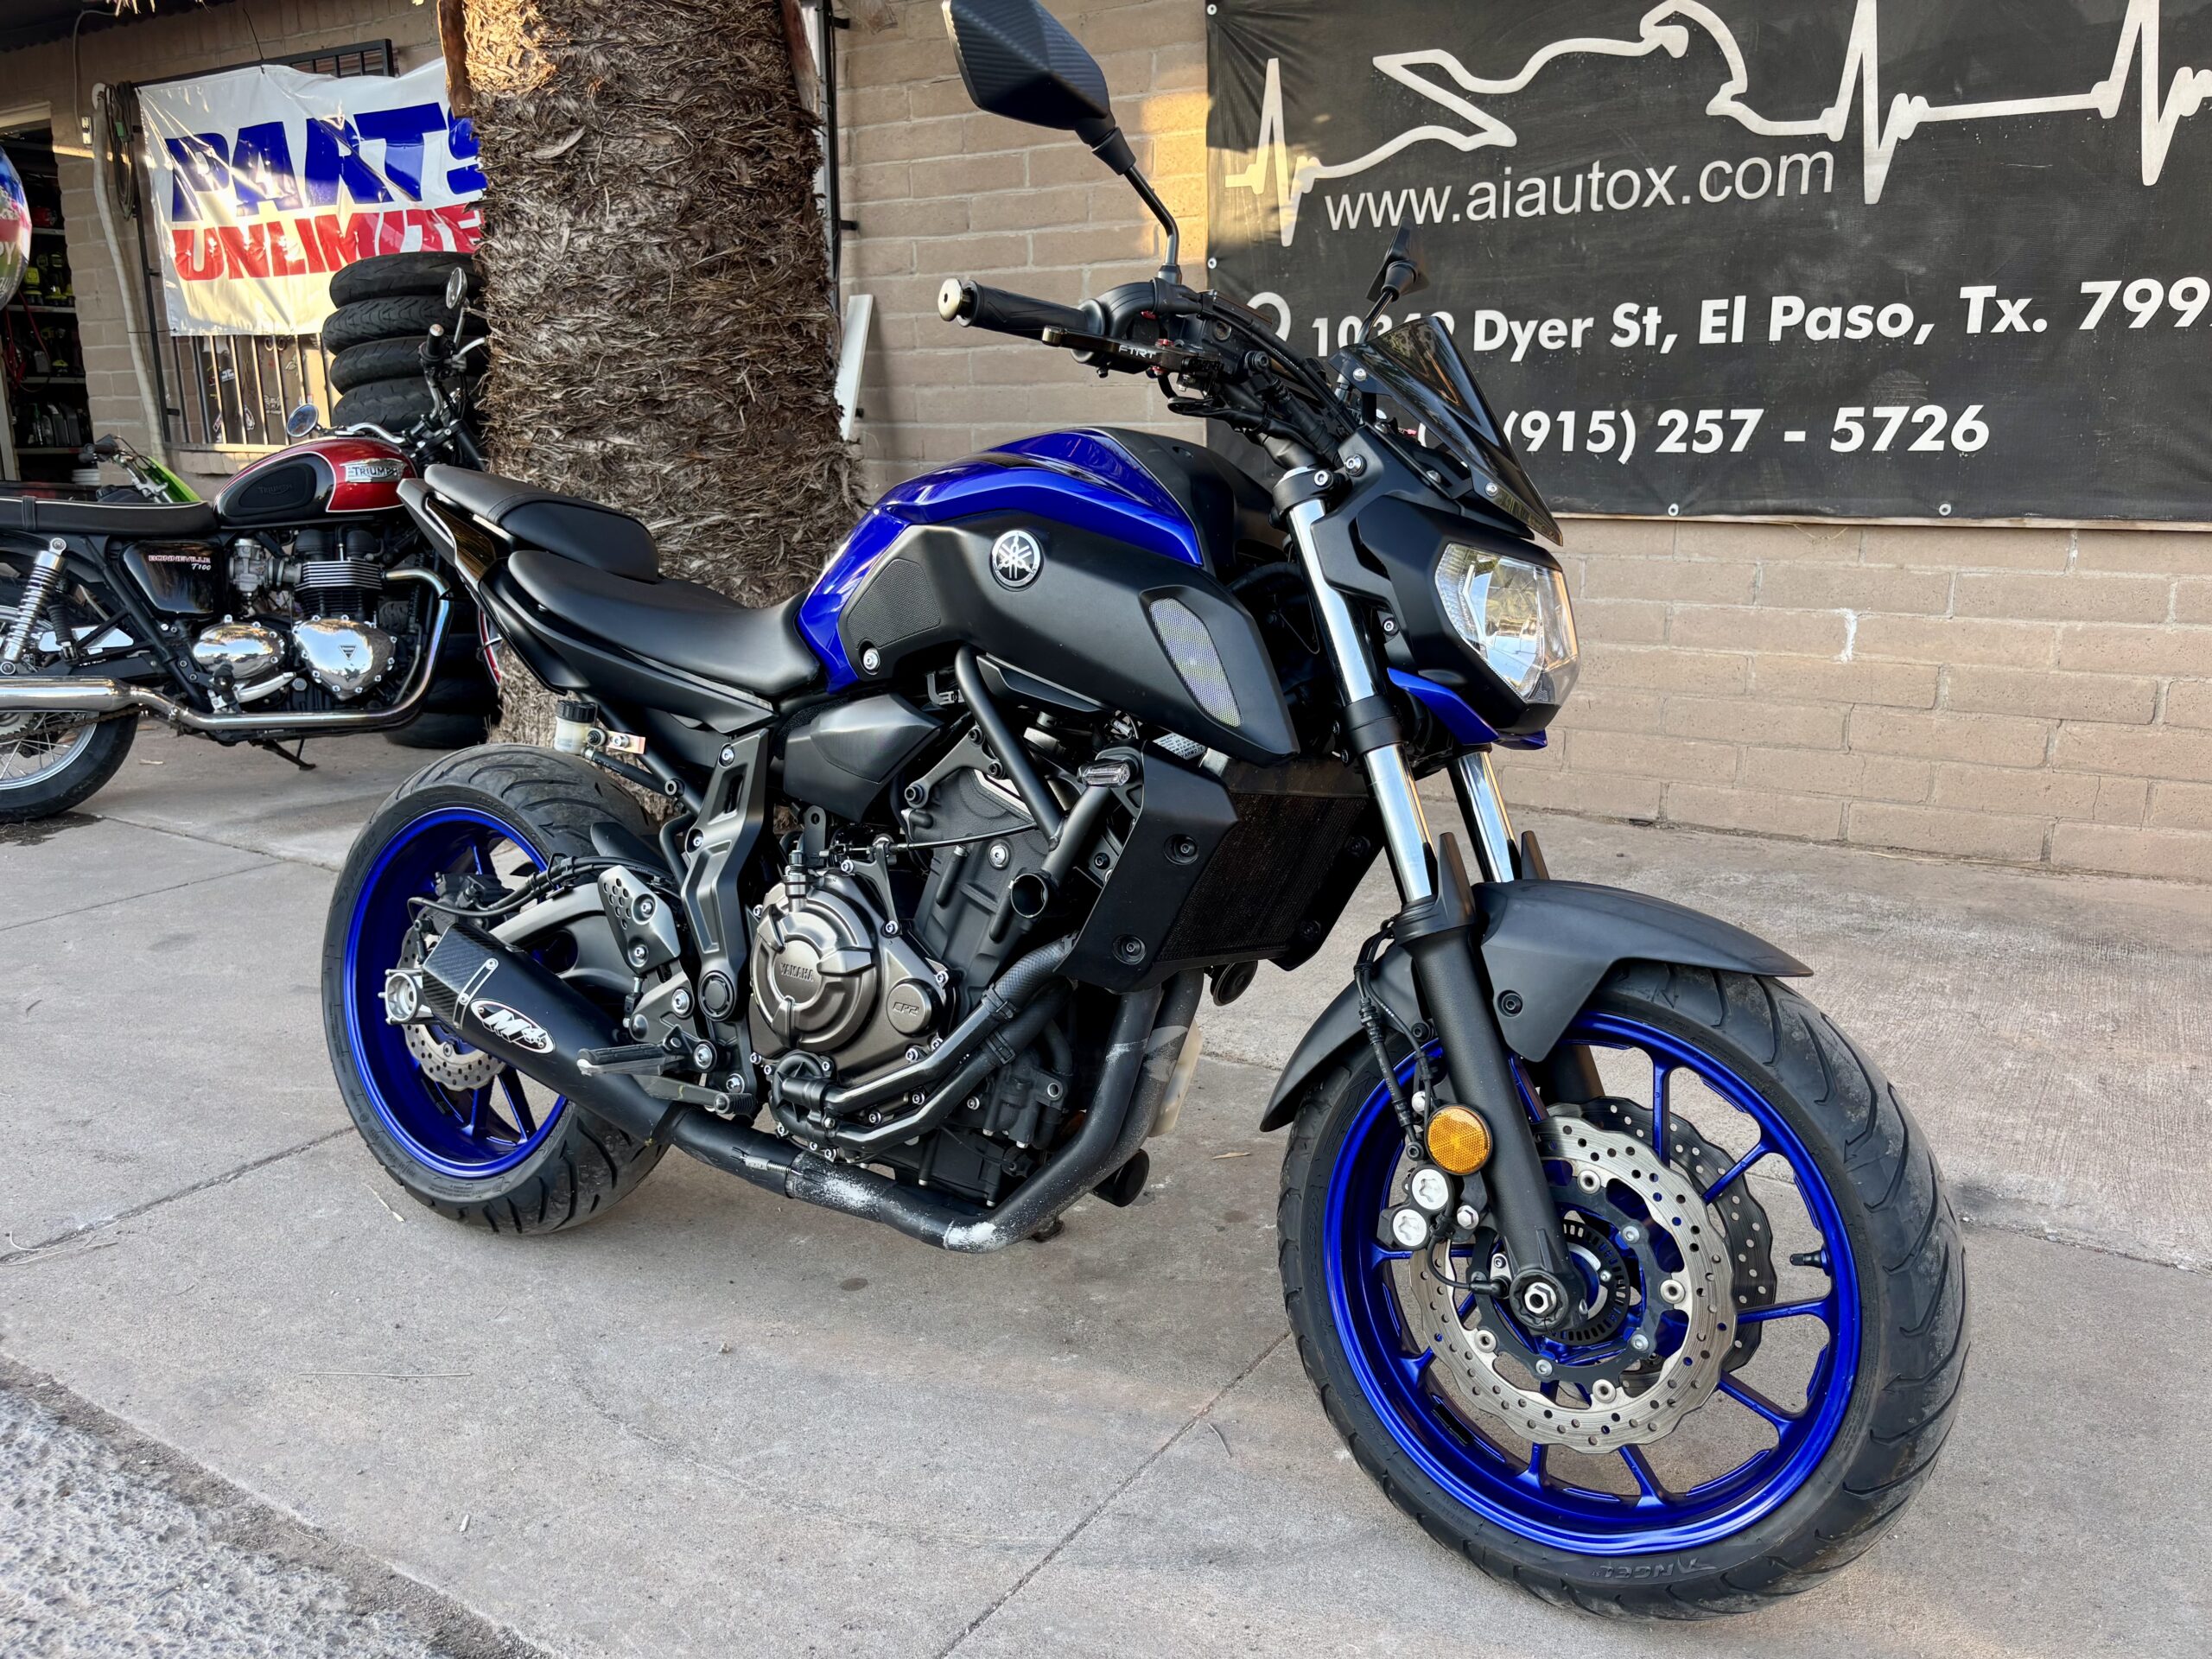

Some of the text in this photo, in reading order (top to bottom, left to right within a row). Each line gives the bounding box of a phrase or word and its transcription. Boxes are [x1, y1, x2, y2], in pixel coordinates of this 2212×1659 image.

[1325, 150, 1834, 231] www.aiautox.com
[172, 202, 486, 281] UNLIMITE
[1473, 309, 1593, 362] Dyer
[1611, 302, 1678, 354] St,
[1700, 296, 1745, 345] El
[1769, 295, 1935, 346] Paso,
[1960, 286, 2048, 334] Tx.
[2079, 276, 2212, 331] 799
[1504, 404, 1990, 465] (915) 257 - 5726
[779, 962, 814, 982] YAMAHA
